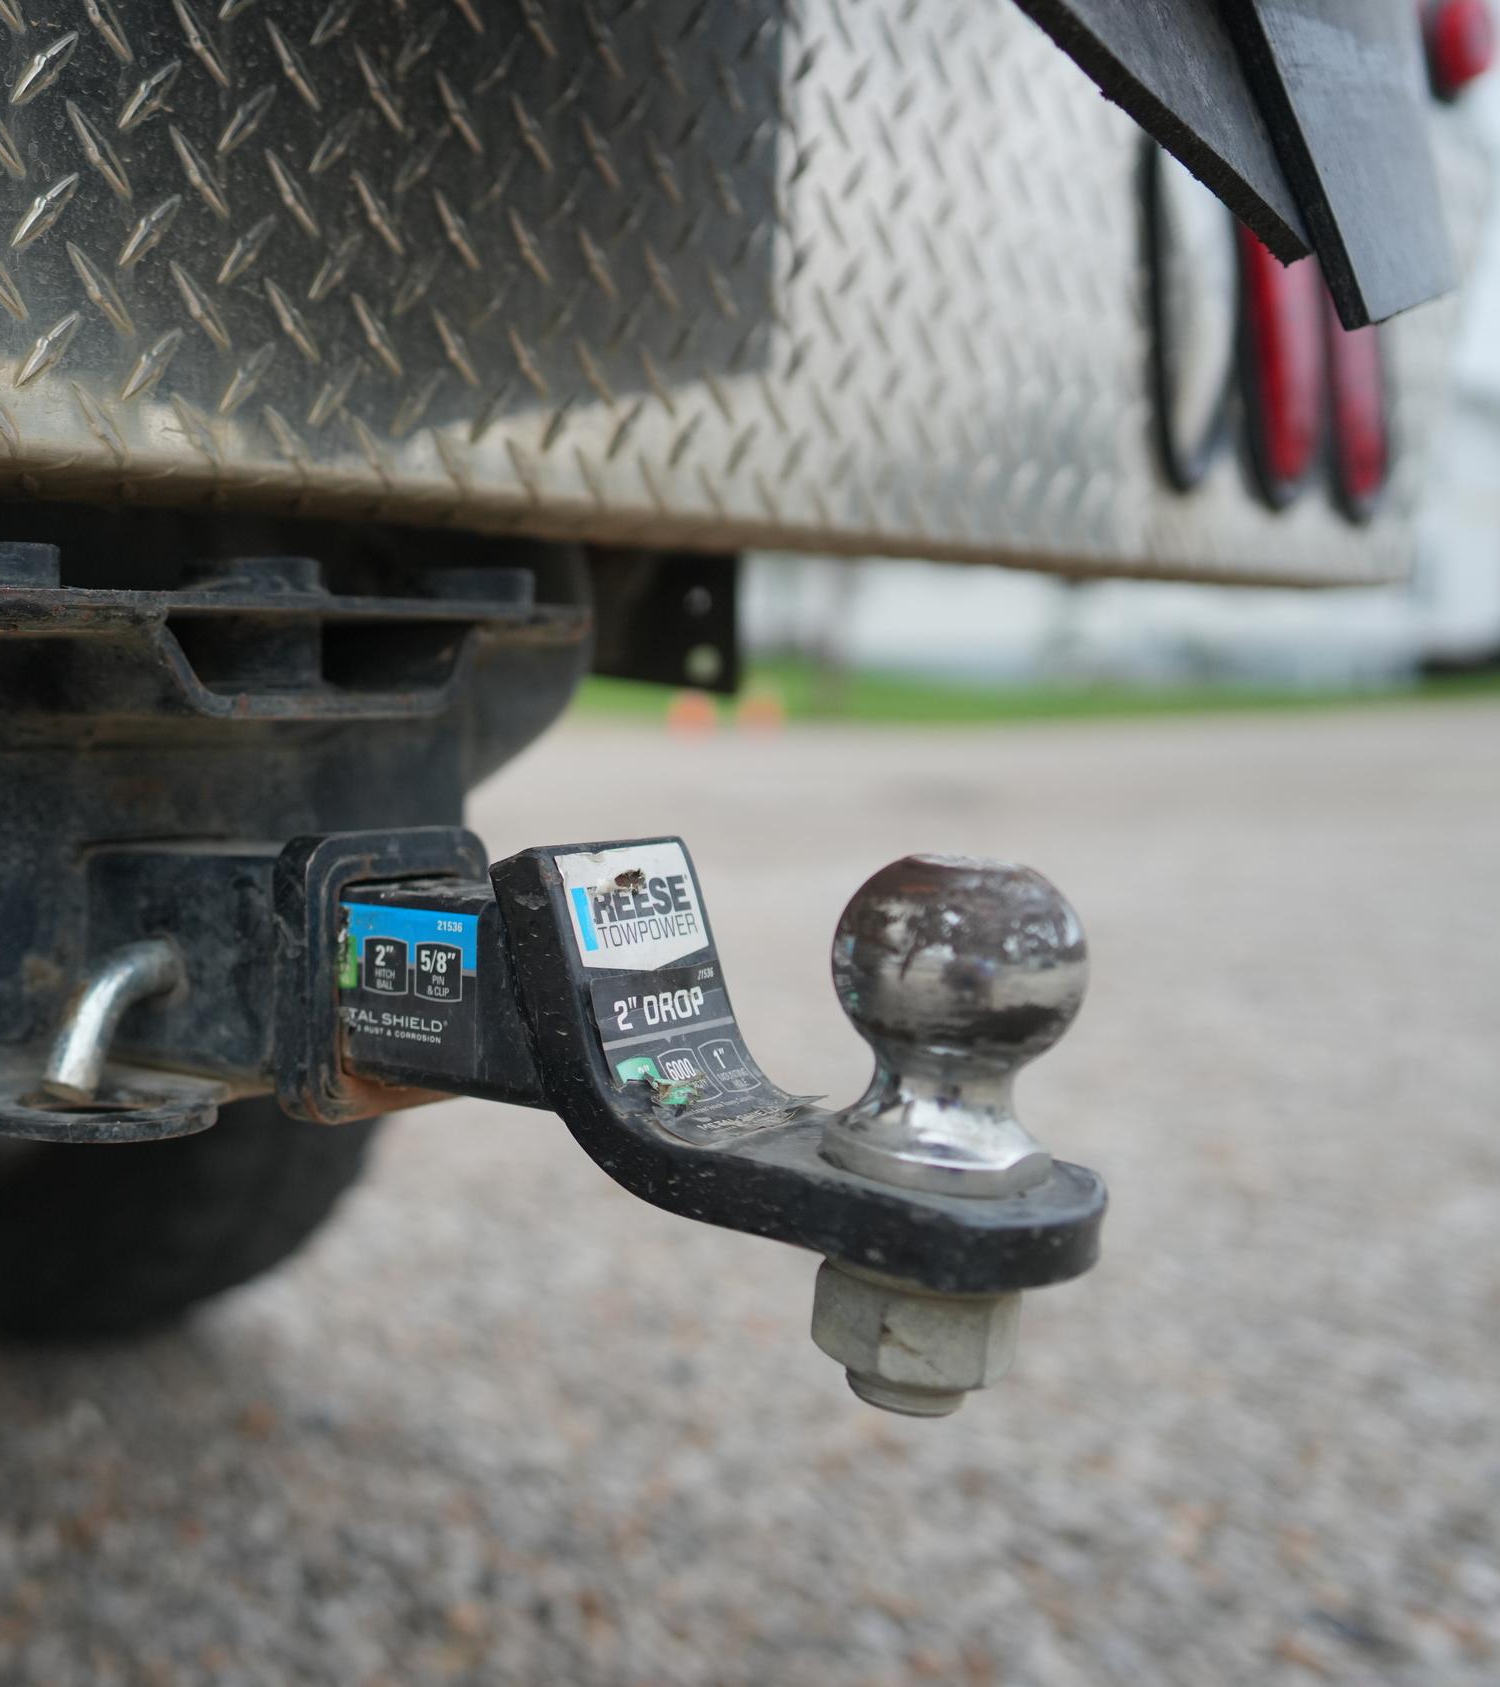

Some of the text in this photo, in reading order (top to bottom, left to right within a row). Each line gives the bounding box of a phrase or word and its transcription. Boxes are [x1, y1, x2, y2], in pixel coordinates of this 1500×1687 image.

[587, 875, 691, 924] REESE
[437, 919, 463, 933] 21536
[597, 913, 698, 948] TOWPOWER
[374, 944, 395, 967] 2"
[420, 949, 456, 974] 5/8"
[374, 967, 396, 980] HITCH
[432, 974, 445, 986] PIN
[376, 978, 394, 990] BALL
[427, 985, 450, 998] & CLIP
[341, 1006, 379, 1024] TAL
[614, 986, 704, 1031] 2" DROP
[363, 1025, 384, 1036] RUST
[394, 1030, 442, 1044] CORROSION
[665, 1058, 697, 1081] 6000
